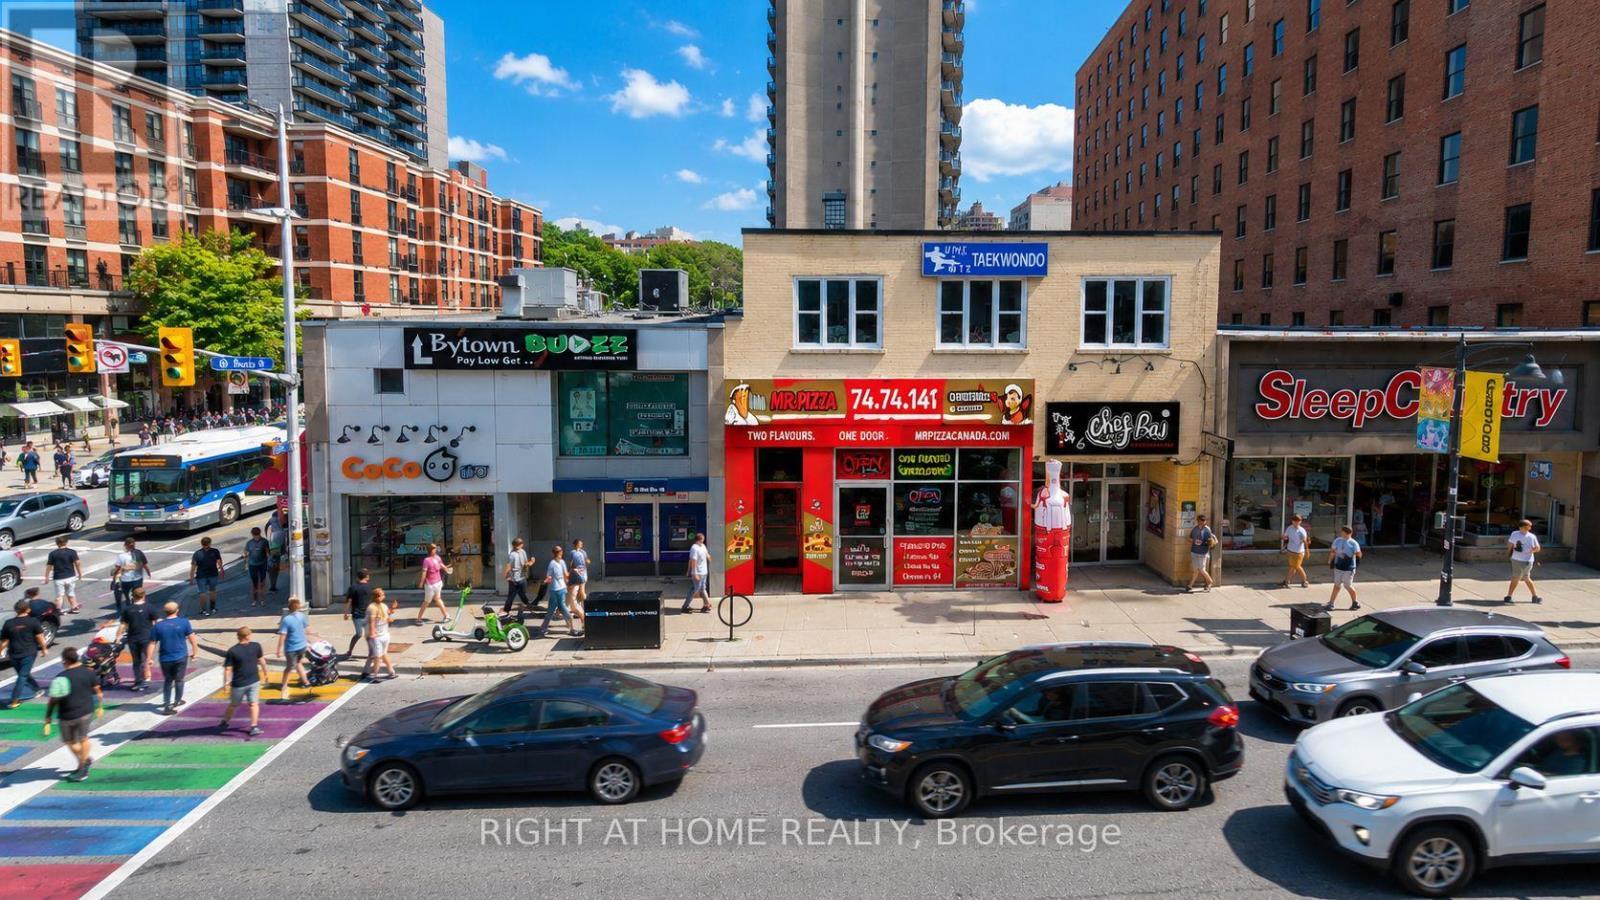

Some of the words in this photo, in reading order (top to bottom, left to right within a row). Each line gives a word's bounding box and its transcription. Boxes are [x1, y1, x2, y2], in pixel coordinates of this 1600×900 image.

[972, 252, 1045, 268] TAEKWONDO
[429, 333, 519, 357] Bytown
[457, 357, 475, 367] Pay
[478, 357, 499, 365] Low
[502, 357, 520, 365] Get
[1255, 370, 1567, 428] SleepCtry
[748, 431, 767, 440] TWO
[769, 431, 815, 440] FLAVOURS.
[839, 431, 857, 440] ONE
[341, 456, 422, 480] CoCo
